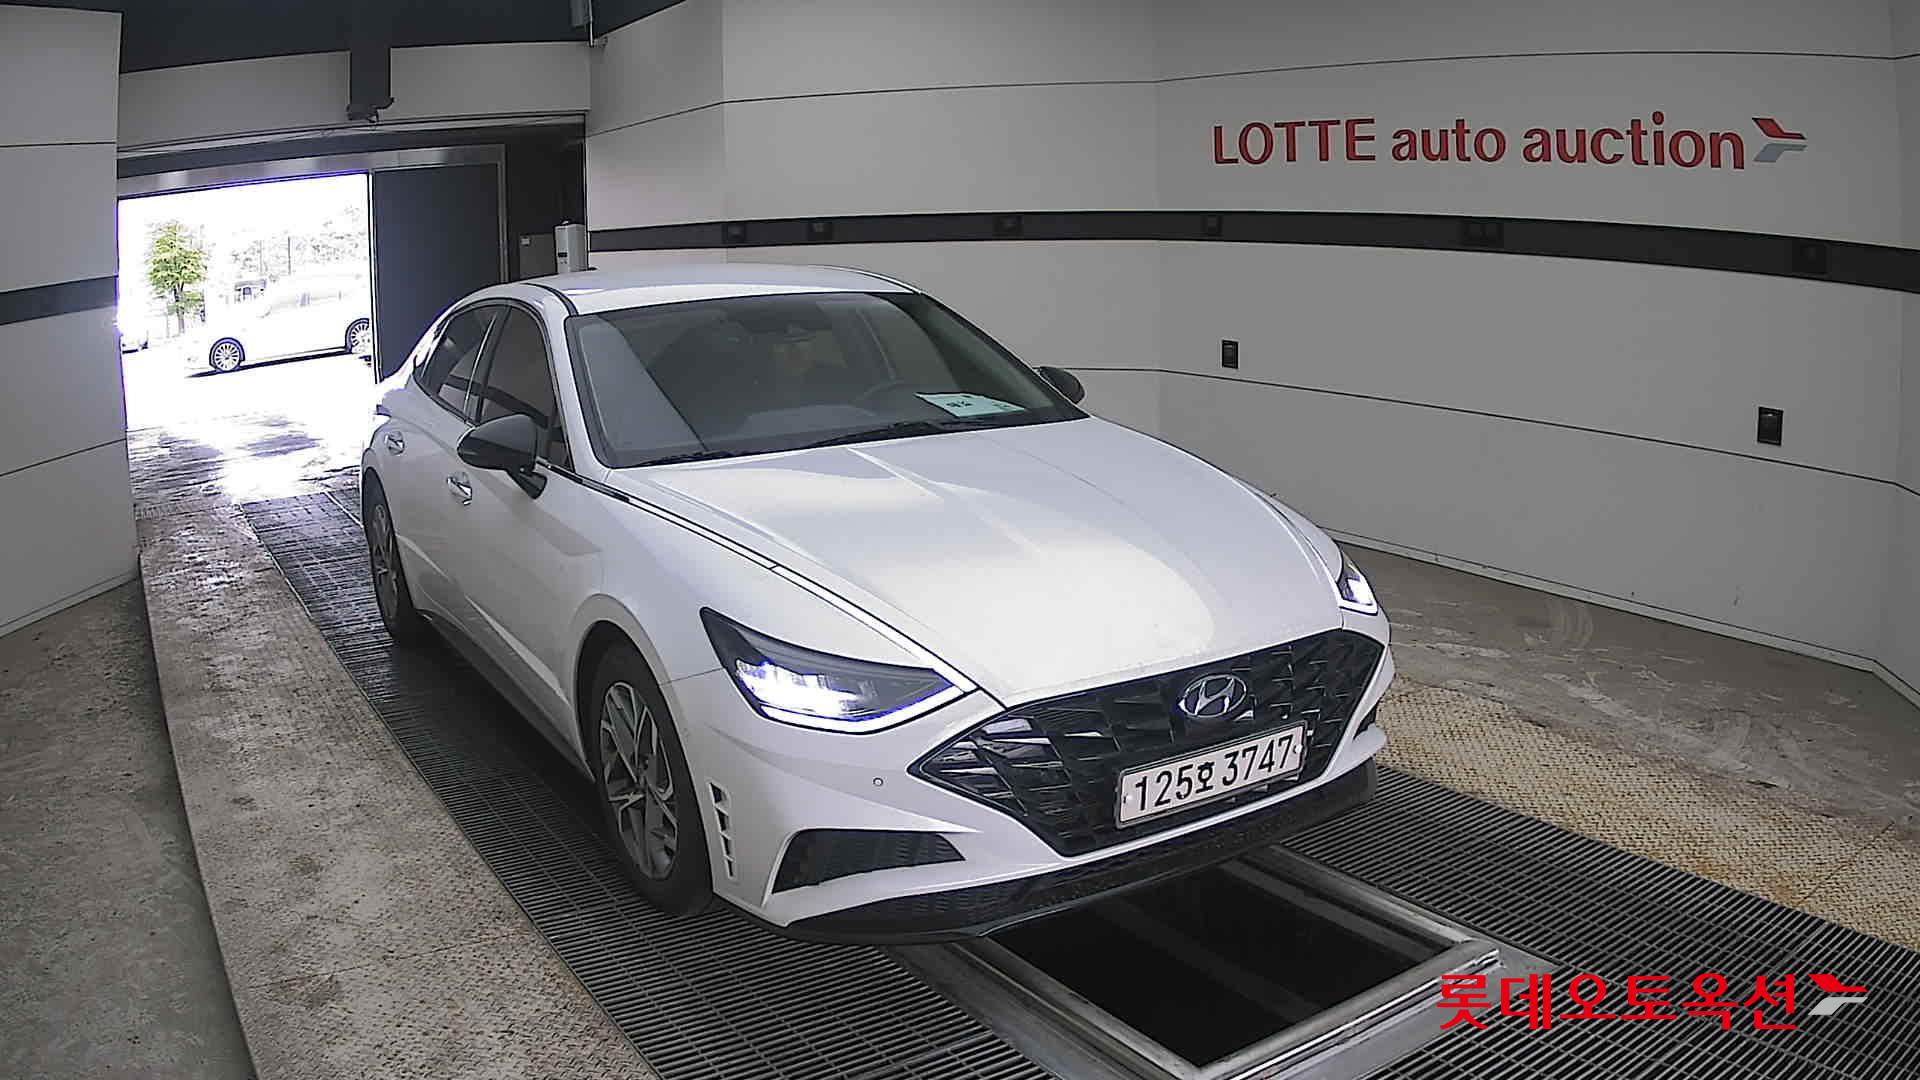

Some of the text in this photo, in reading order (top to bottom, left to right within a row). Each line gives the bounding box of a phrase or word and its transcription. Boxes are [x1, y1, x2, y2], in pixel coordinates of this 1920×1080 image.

[1213, 111, 1746, 170] LOTTE auto auction
[1135, 734, 1294, 811] 125호 3747
